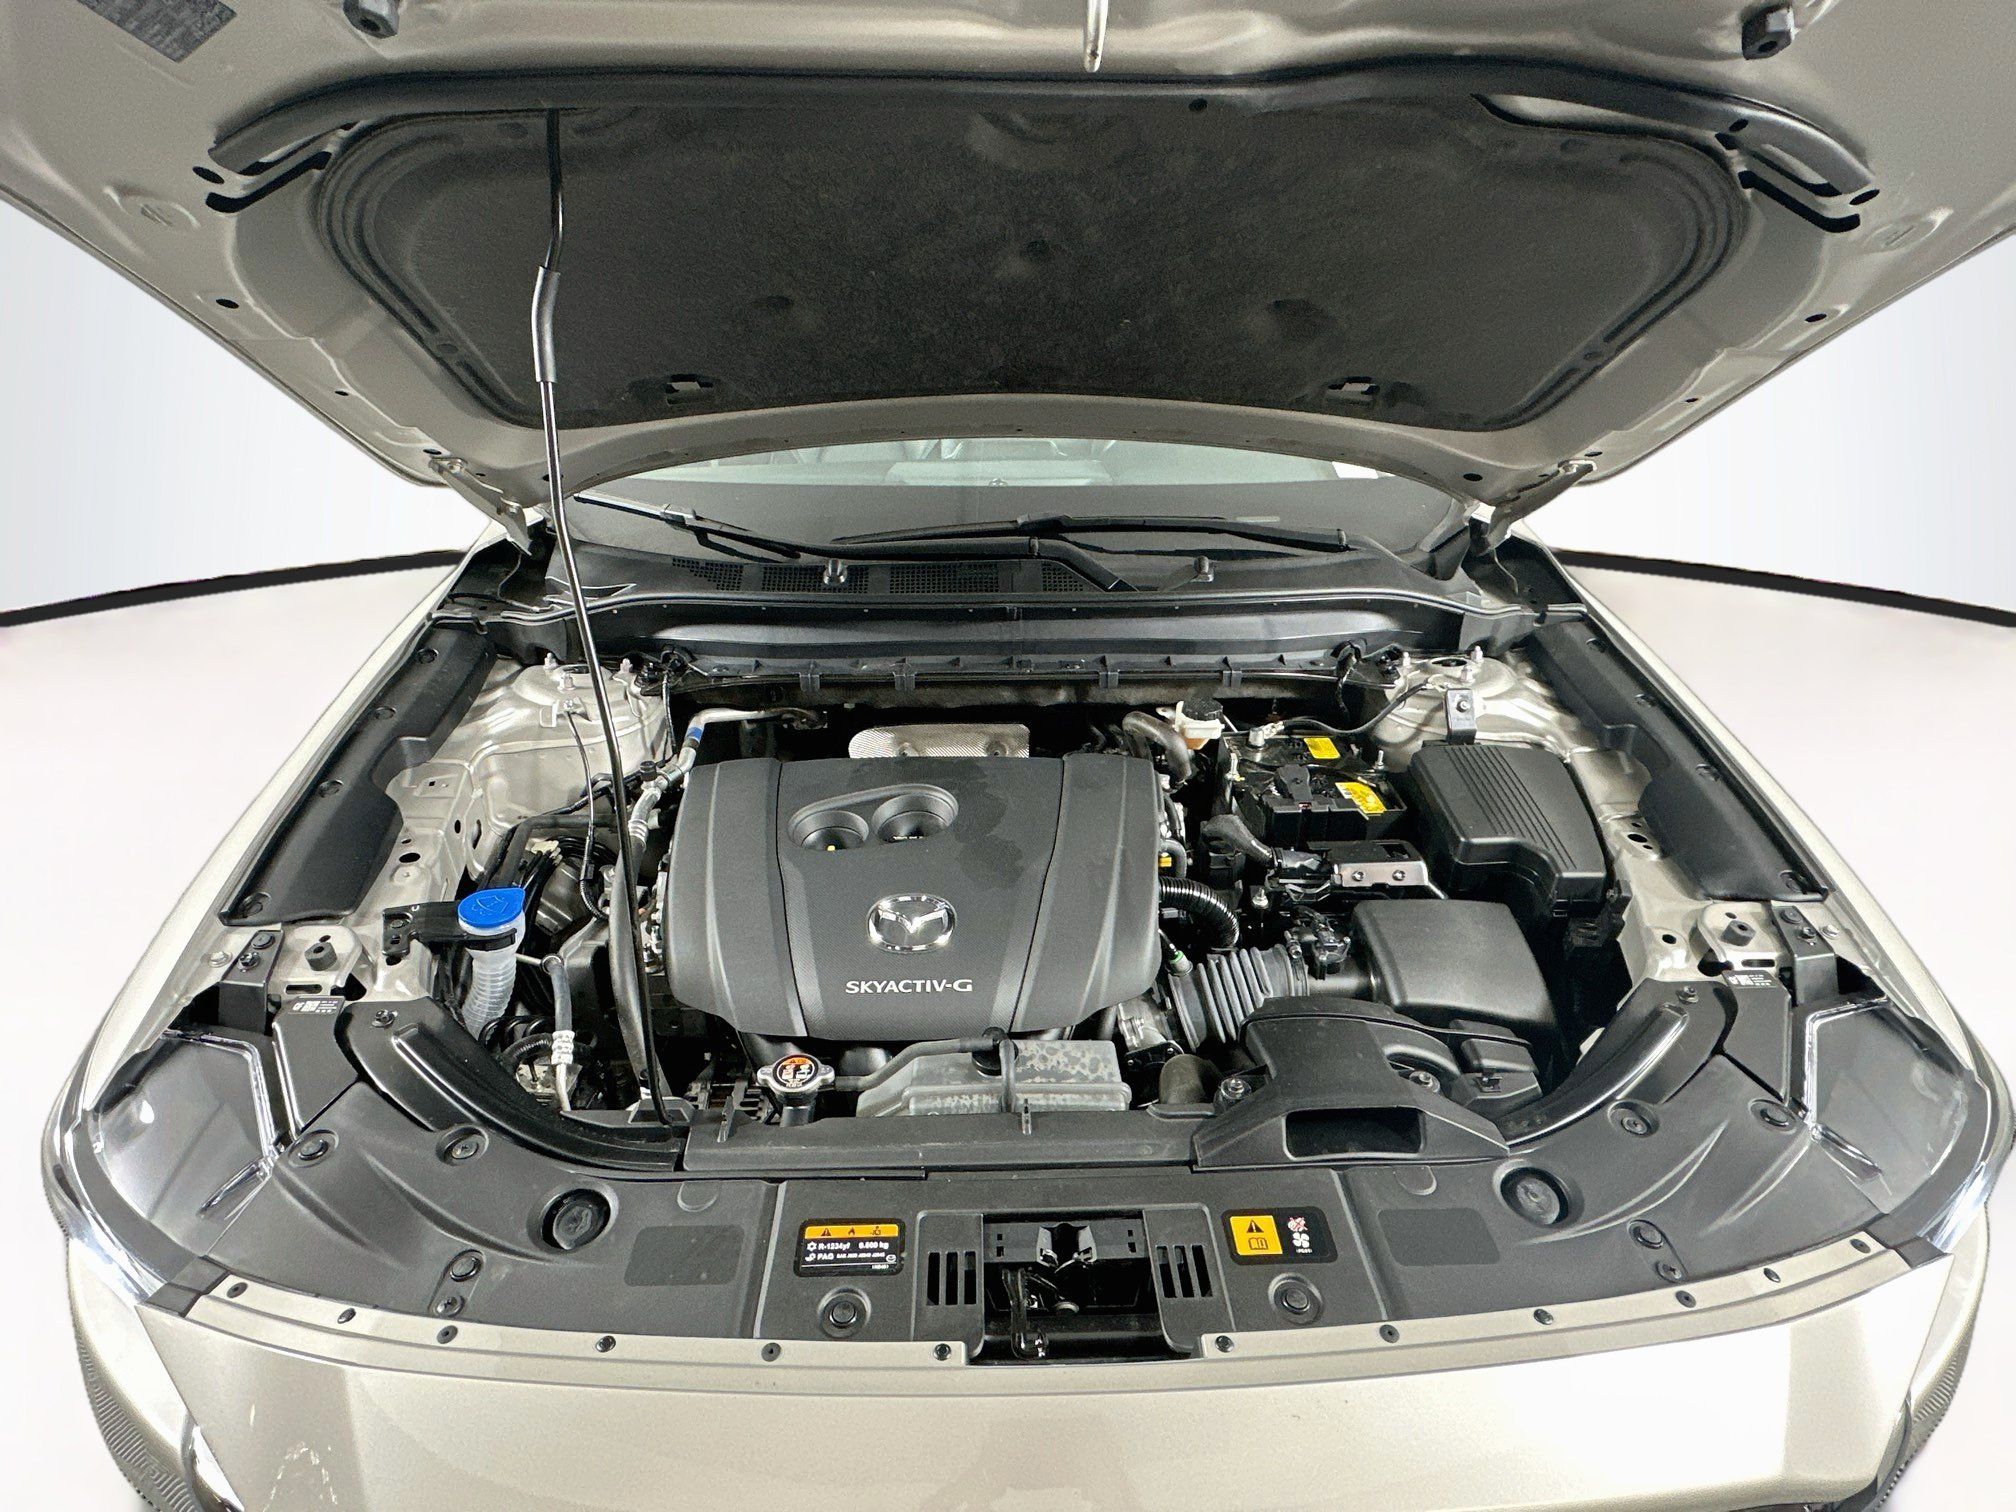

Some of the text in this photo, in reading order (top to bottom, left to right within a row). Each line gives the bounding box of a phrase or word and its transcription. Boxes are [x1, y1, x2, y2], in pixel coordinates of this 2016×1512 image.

[845, 978, 973, 994] SKYACTIV-G
[818, 1242, 851, 1251] R-1234yf
[879, 1241, 889, 1250] kg
[817, 1252, 834, 1260] PAG
